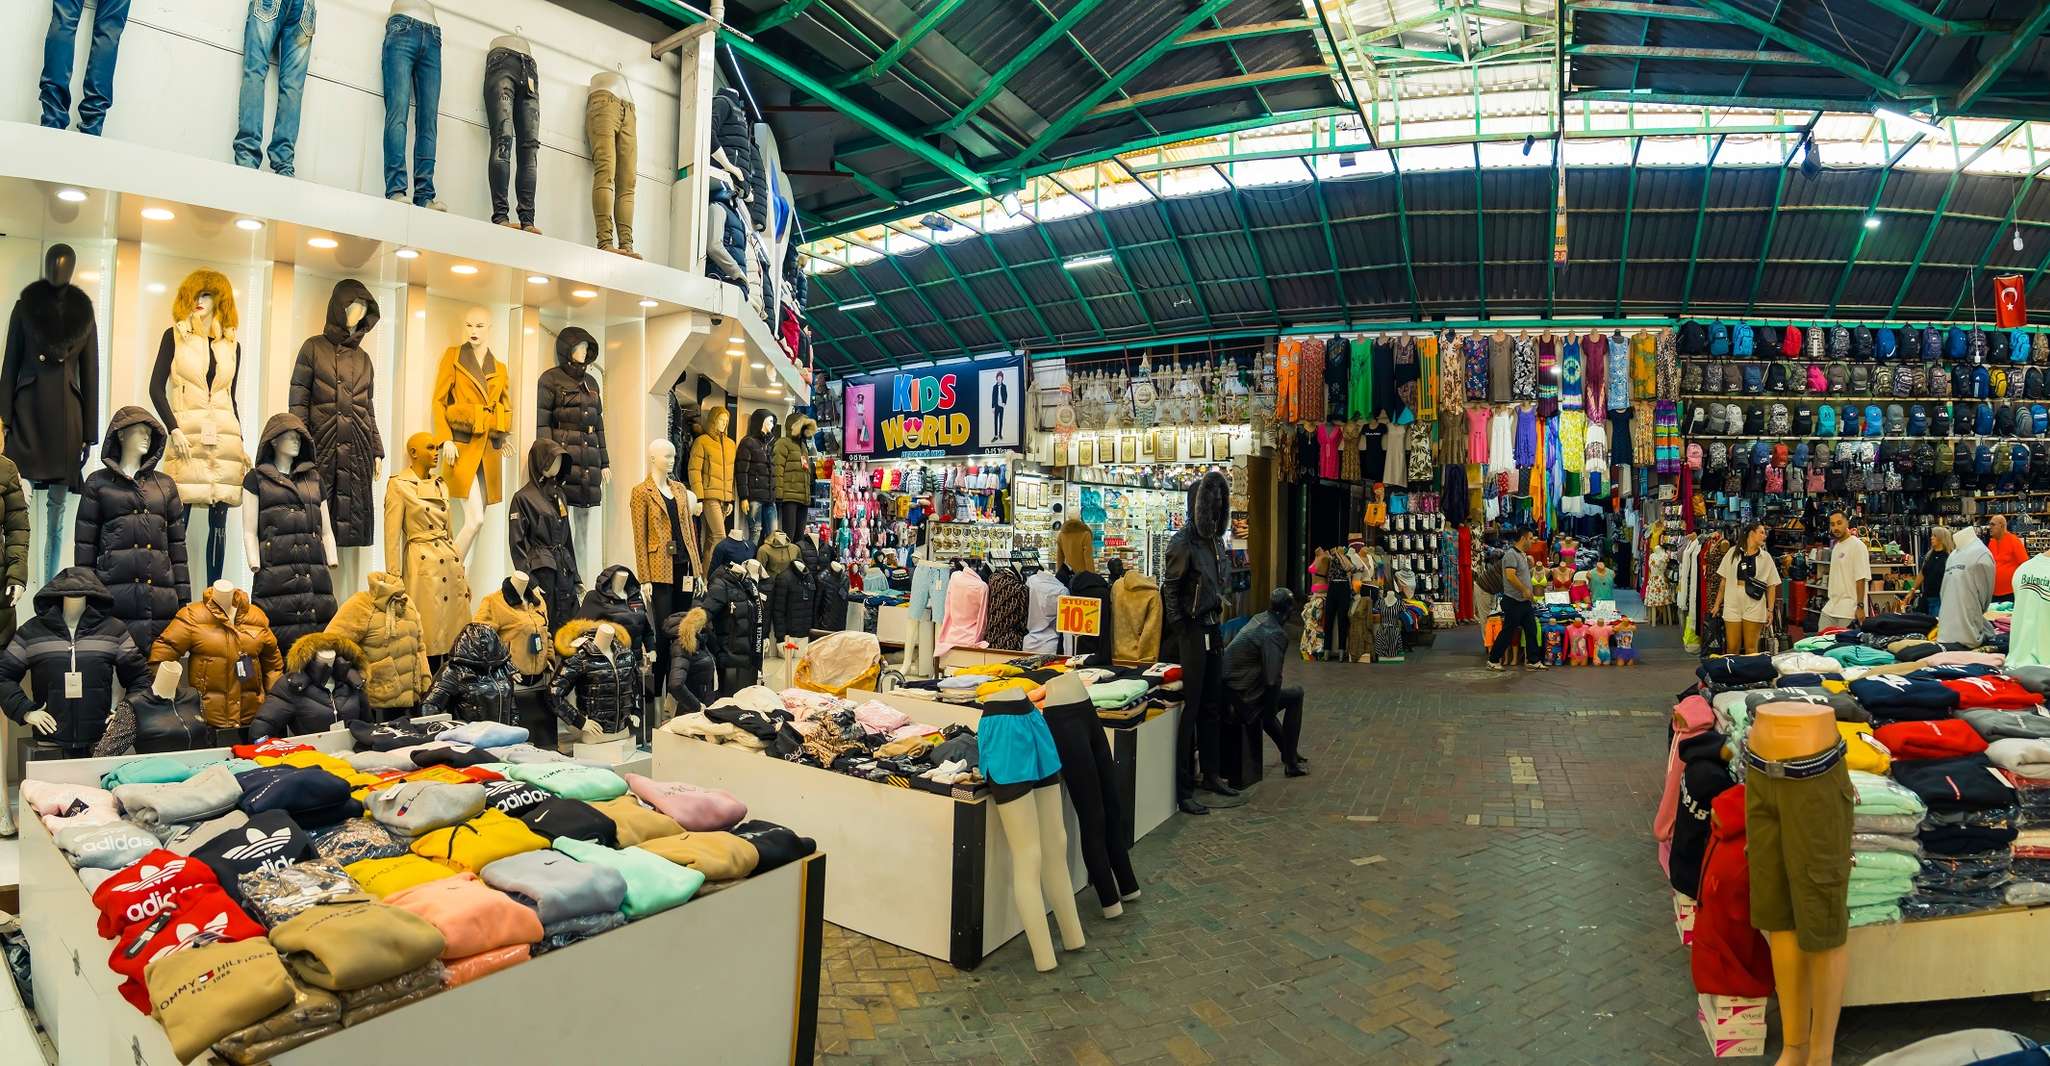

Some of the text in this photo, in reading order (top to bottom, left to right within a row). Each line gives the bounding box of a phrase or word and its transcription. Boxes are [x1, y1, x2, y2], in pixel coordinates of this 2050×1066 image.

[892, 374, 957, 413] KIDS
[881, 413, 971, 452] WORLD
[2020, 573, 2050, 591] Balencia
[1060, 605, 1093, 634] 10 €
[82, 835, 154, 852] adidas
[159, 980, 196, 1011] OMMY
